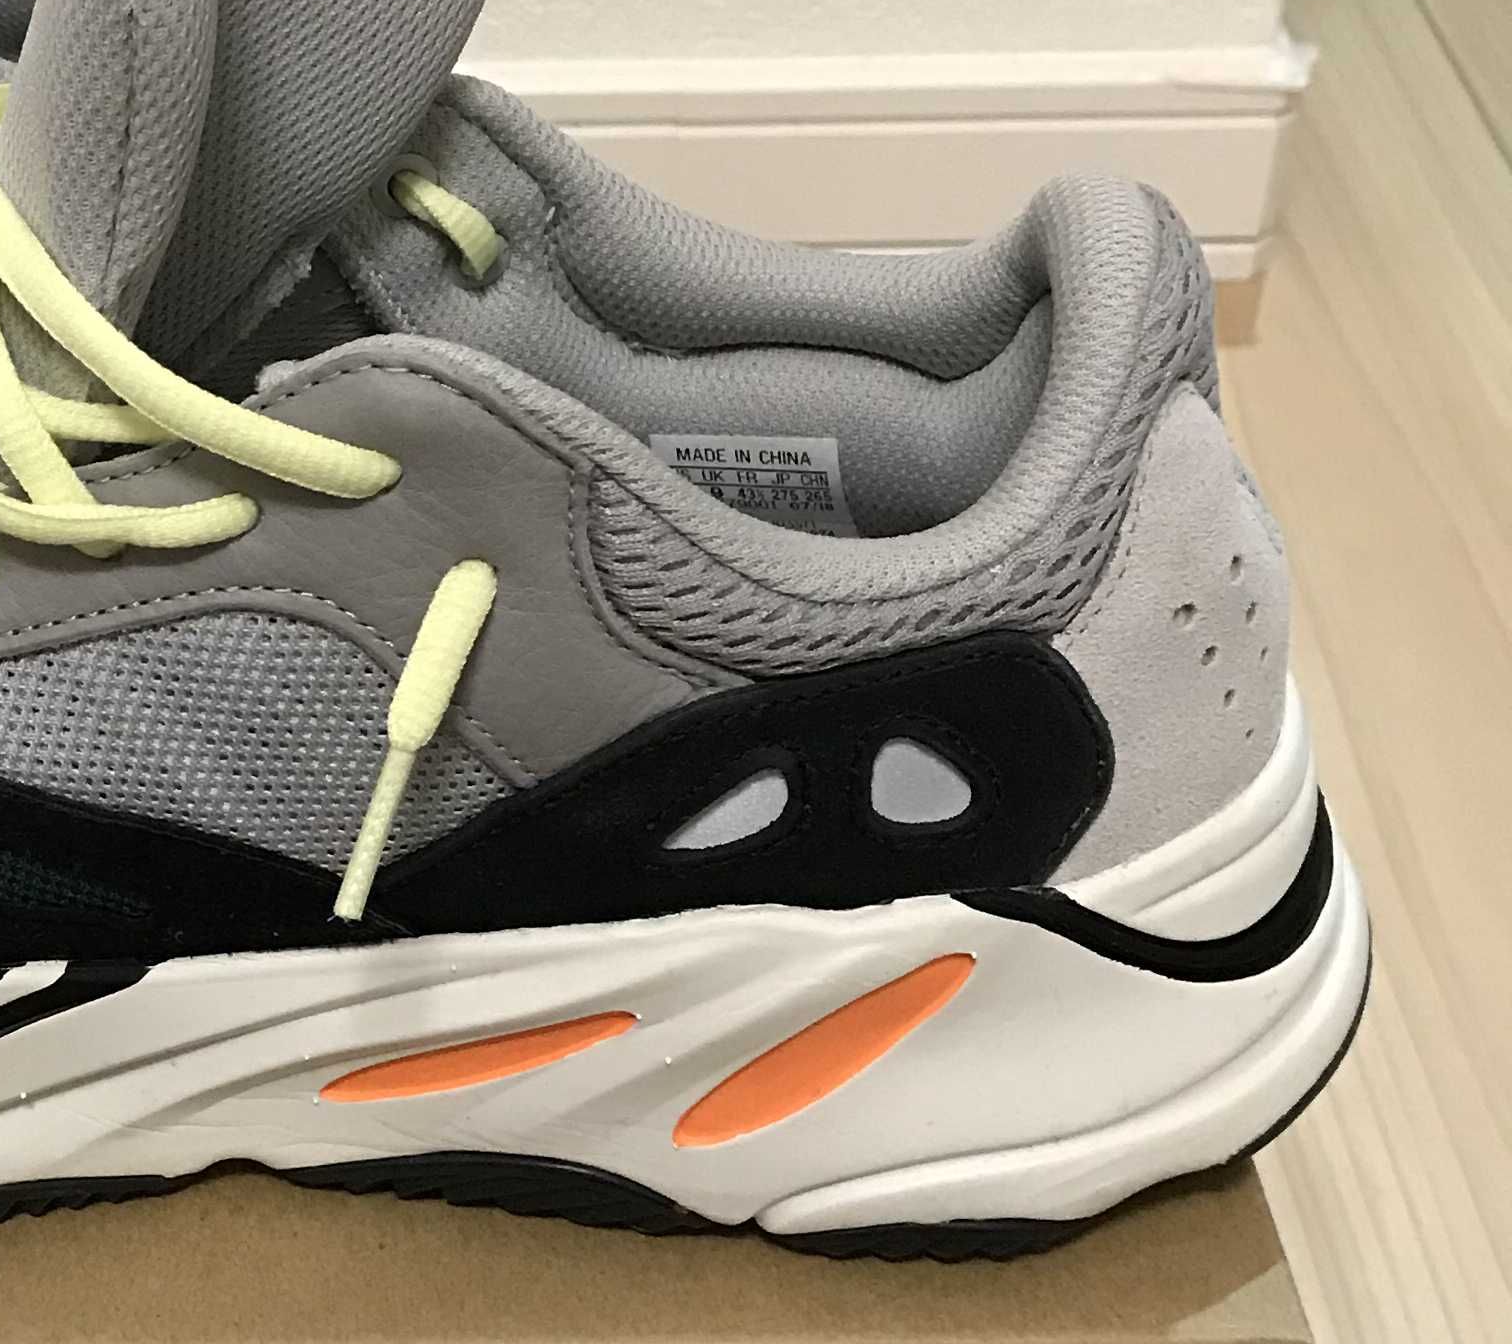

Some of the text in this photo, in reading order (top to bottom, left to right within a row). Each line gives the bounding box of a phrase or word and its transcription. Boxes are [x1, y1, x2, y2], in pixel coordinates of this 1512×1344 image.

[676, 447, 812, 466] MADE IN CHINA
[701, 470, 725, 482] UK
[737, 471, 758, 484] FR
[771, 472, 791, 485] JP
[800, 473, 830, 487] CHN
[771, 489, 799, 502] 275
[804, 490, 833, 503] 265
